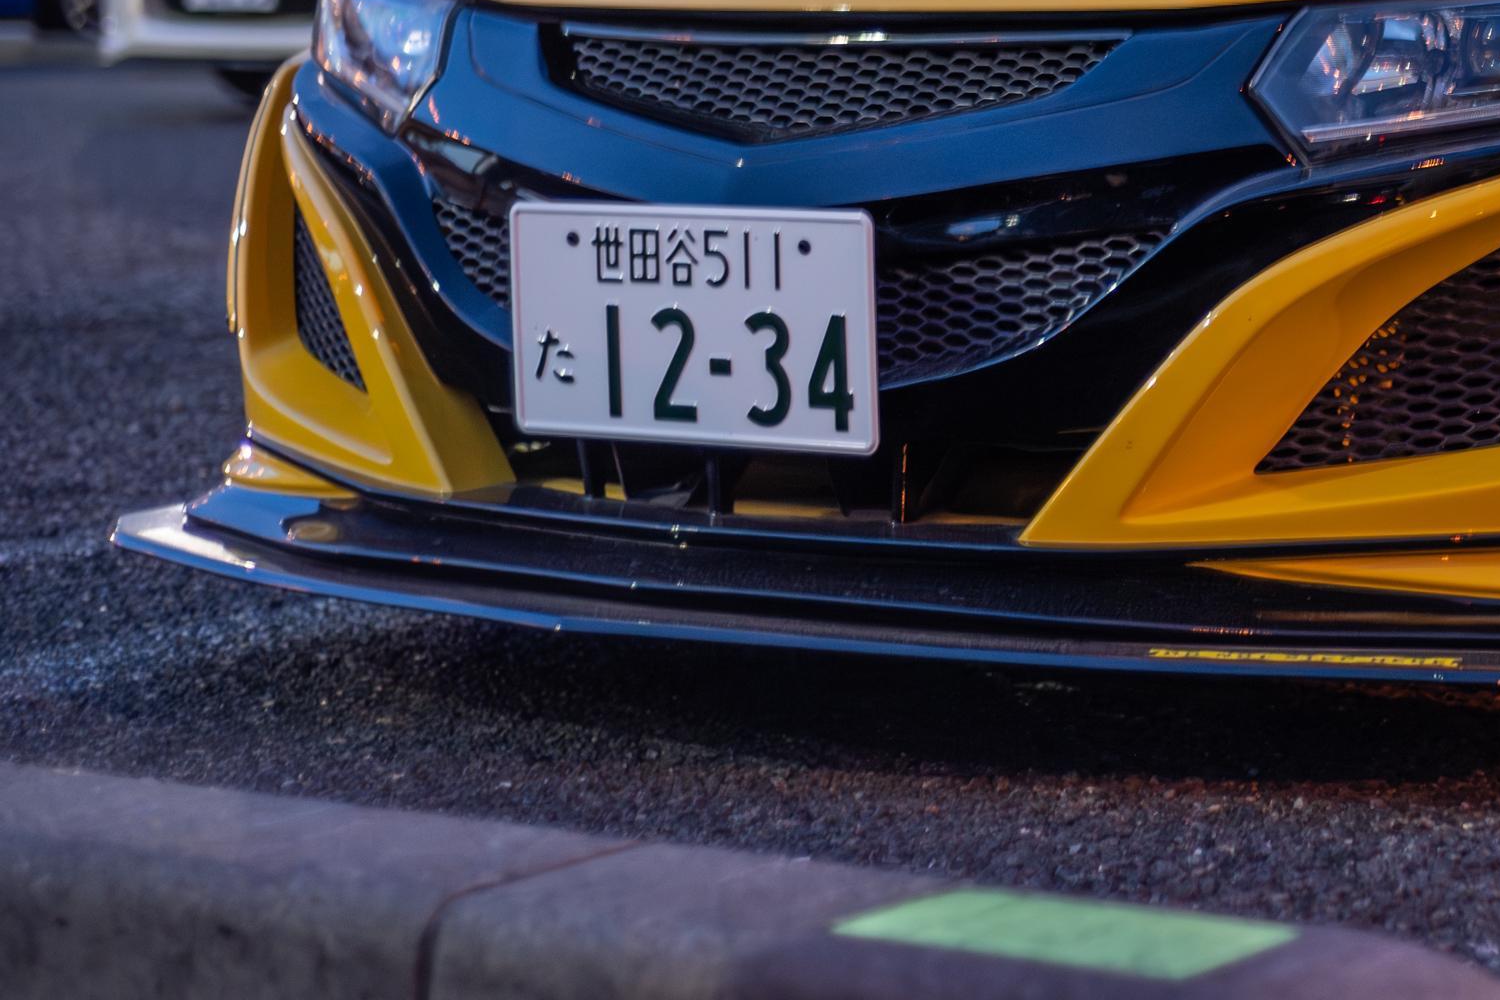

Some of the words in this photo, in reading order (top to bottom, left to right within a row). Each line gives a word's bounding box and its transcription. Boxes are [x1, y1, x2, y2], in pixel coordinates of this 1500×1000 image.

[591, 224, 781, 290] 世田谷511
[535, 328, 576, 384] た
[605, 302, 855, 433] 12-34
